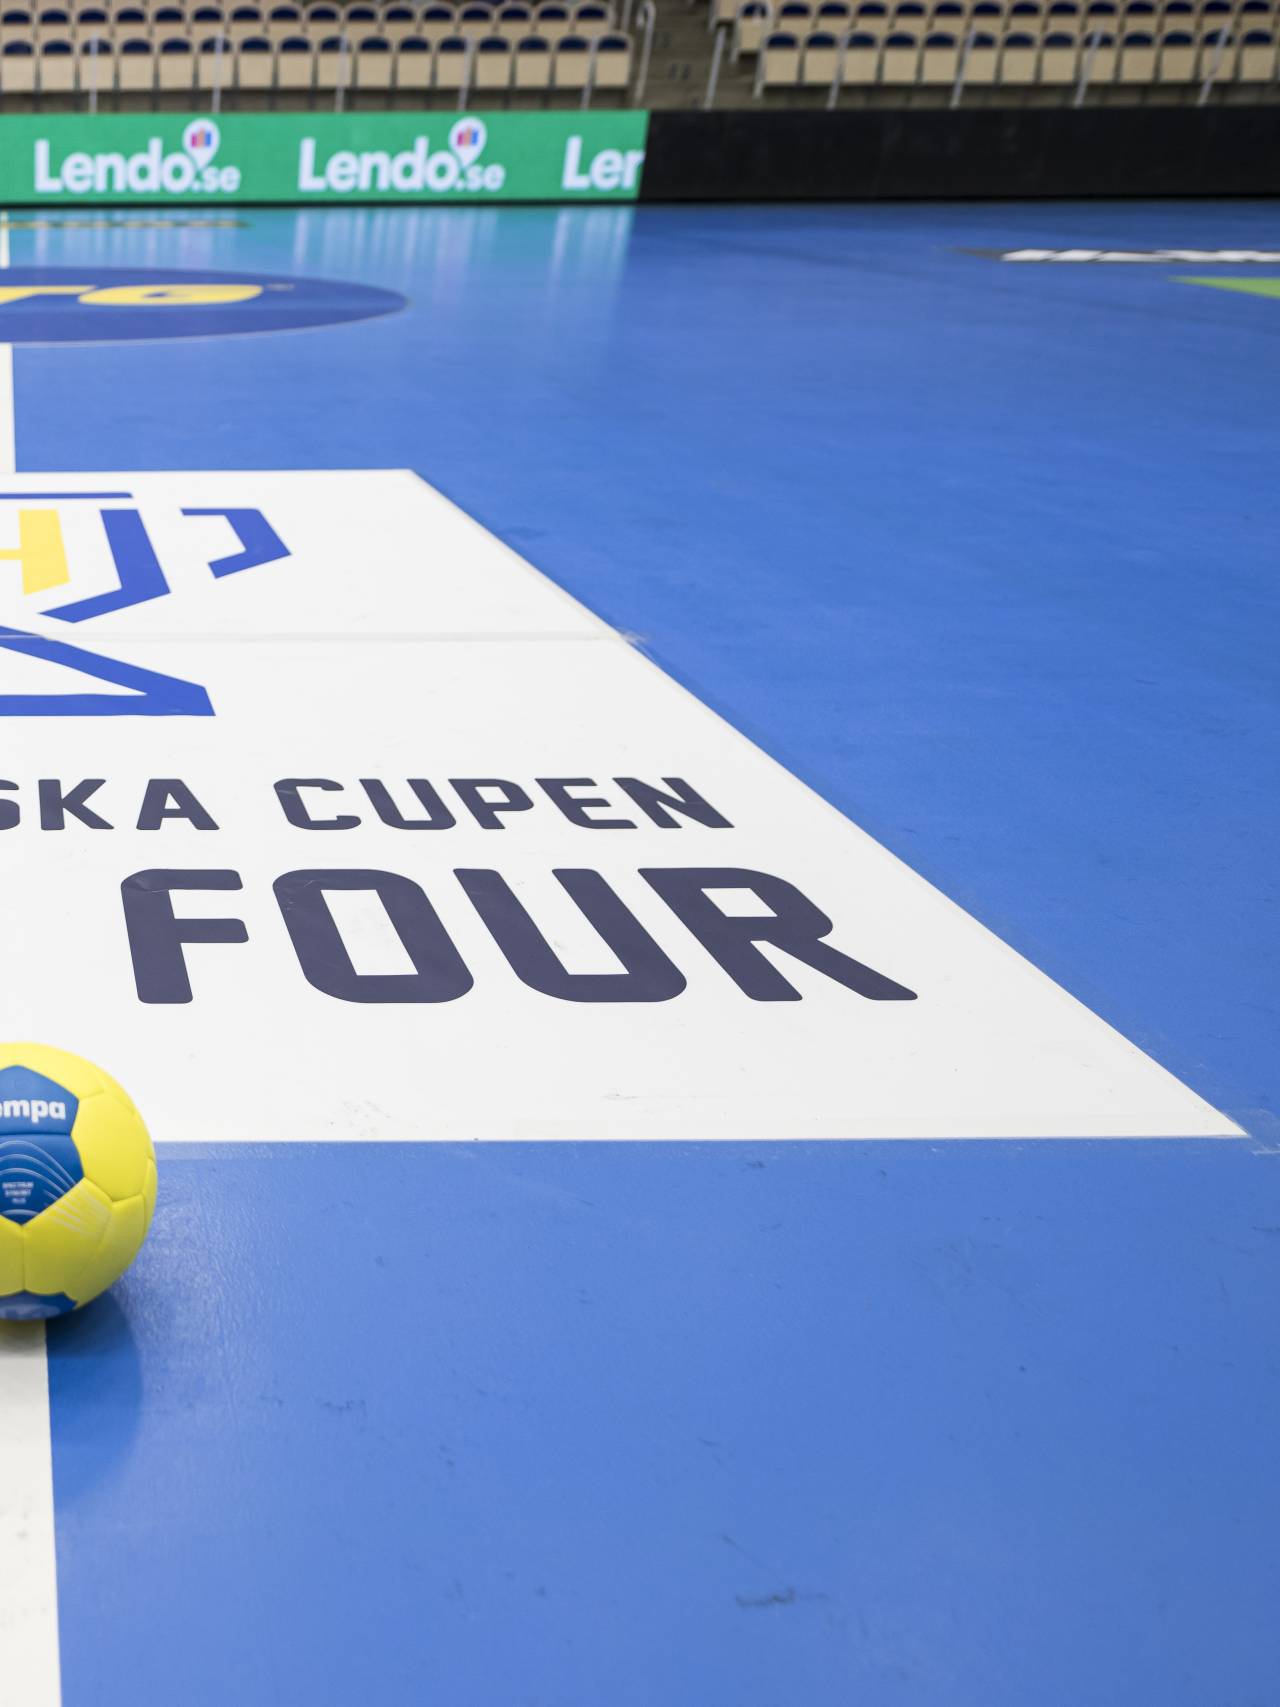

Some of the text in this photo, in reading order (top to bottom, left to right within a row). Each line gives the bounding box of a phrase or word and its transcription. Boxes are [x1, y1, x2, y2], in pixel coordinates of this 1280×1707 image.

[33, 137, 241, 194] Lendo.se
[297, 136, 505, 192] Lendo.se
[273, 777, 735, 831] CUPEN
[120, 867, 919, 1005] FOUR
